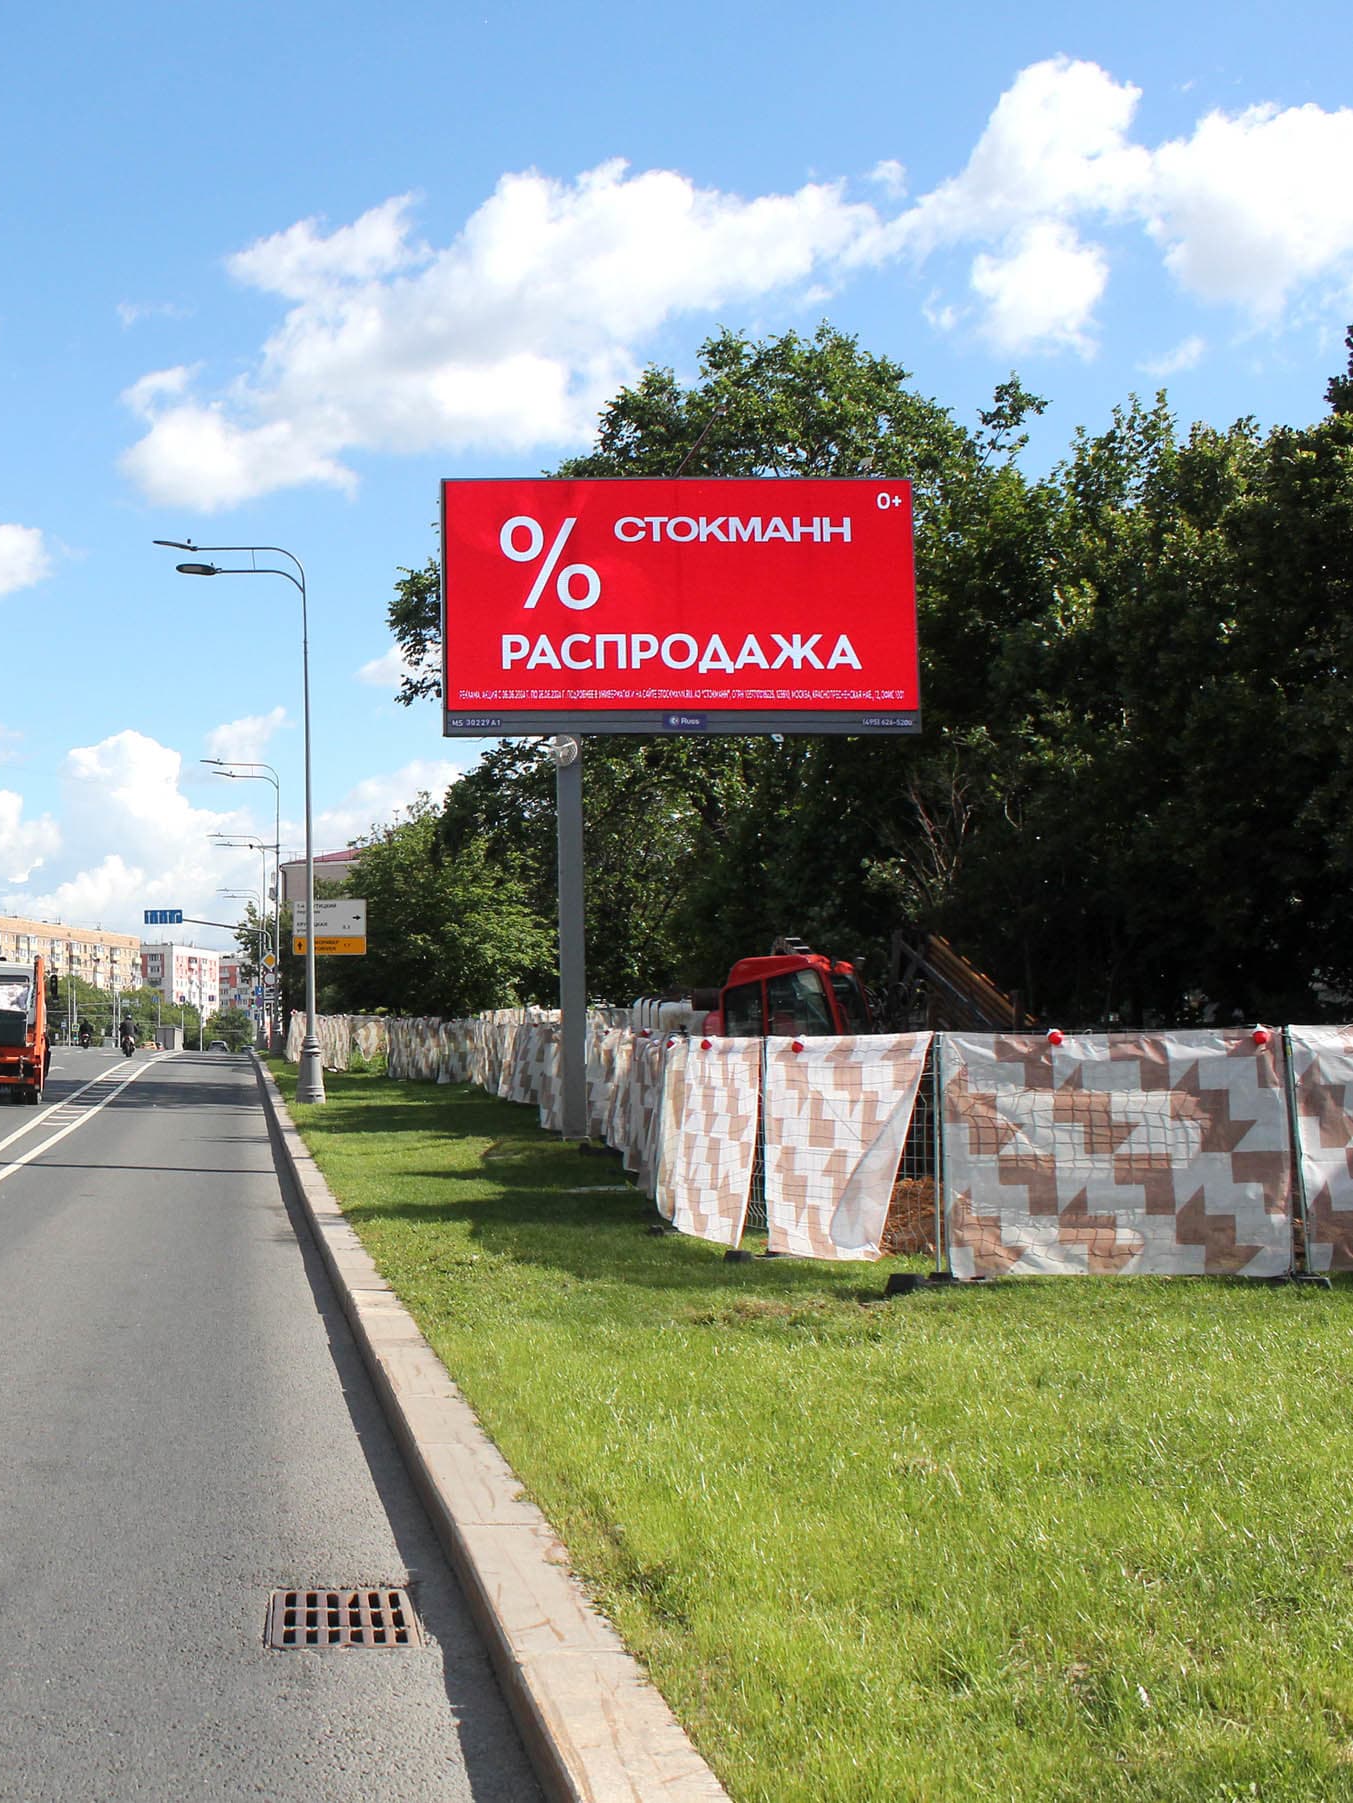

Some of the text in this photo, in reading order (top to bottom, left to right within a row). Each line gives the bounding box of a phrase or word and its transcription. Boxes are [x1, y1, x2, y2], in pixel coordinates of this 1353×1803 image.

[877, 493, 901, 509] 0+
[615, 517, 851, 542] СТОКМАНН
[500, 516, 600, 610] %
[502, 633, 862, 673] РАСПРОДАЖА
[681, 717, 700, 725] Russ
